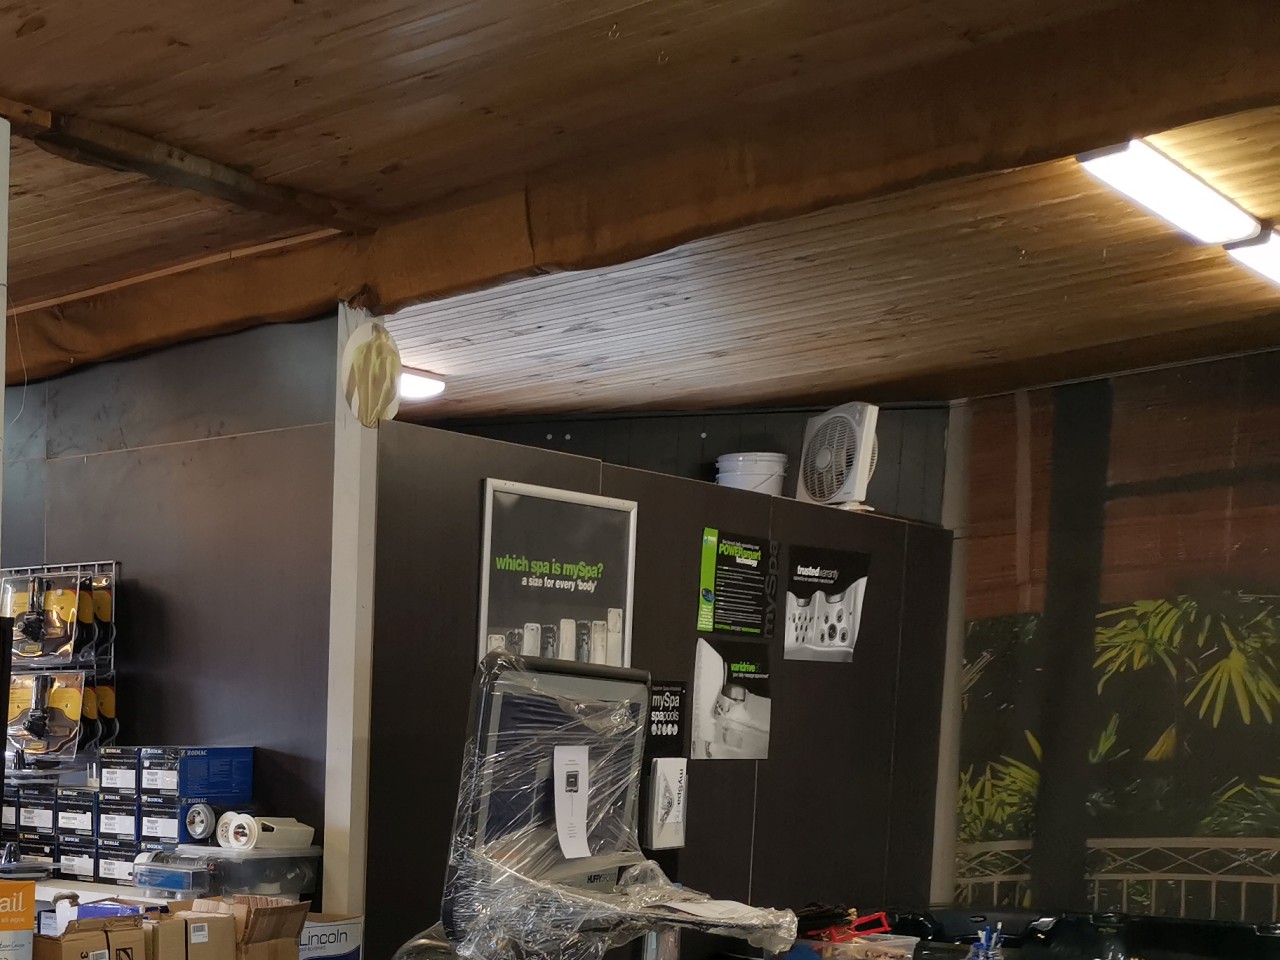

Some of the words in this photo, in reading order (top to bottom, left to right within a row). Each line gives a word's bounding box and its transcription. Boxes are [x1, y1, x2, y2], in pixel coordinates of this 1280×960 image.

[496, 554, 529, 572] which
[531, 560, 549, 575] spa
[552, 558, 561, 574] is
[563, 561, 604, 580] mySpa?
[521, 577, 528, 586] a
[528, 575, 543, 587] size
[544, 576, 554, 588] for
[555, 580, 576, 592] every
[652, 692, 680, 710] mySpa
[300, 929, 348, 946] Lincoln
